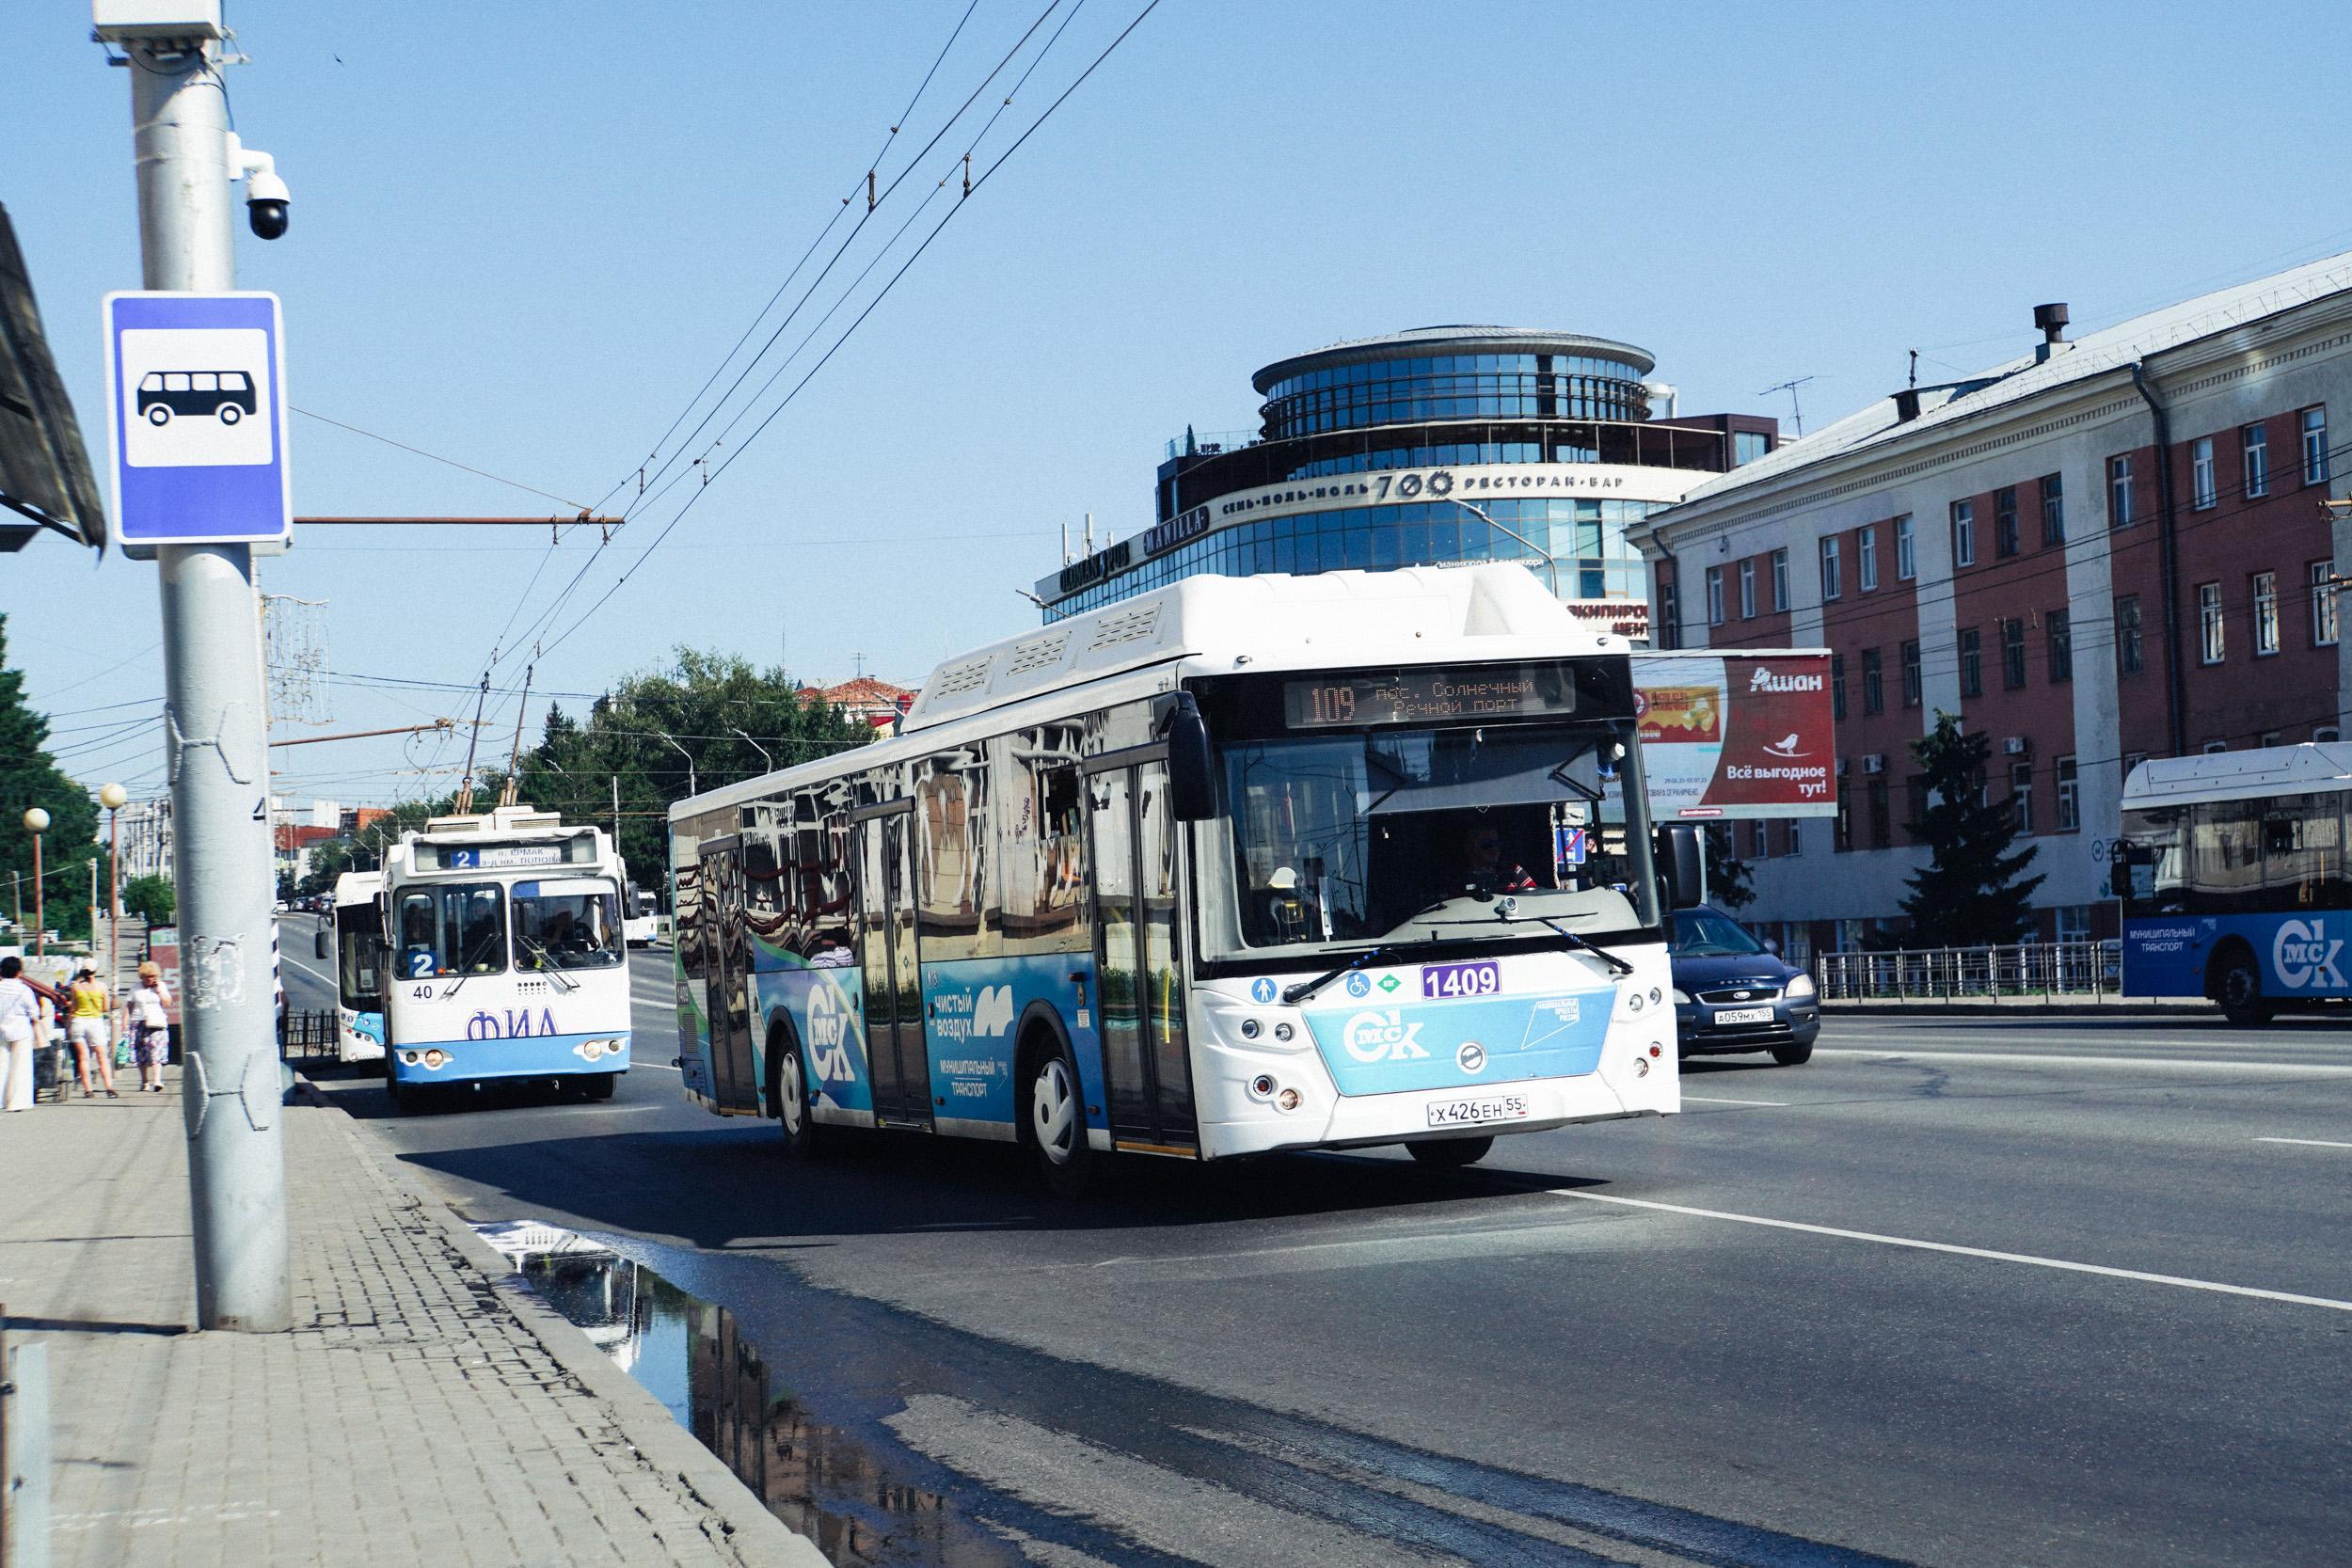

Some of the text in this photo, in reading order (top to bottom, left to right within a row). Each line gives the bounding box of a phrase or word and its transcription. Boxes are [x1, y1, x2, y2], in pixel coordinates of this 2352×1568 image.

[1379, 470, 1455, 499] 700
[1145, 508, 1203, 553] MANILLA
[1750, 667, 1822, 692] Ашан
[1375, 679, 1534, 701] пос. Солнечный
[1311, 687, 1356, 722] 109
[1393, 699, 1518, 716] Речной порт
[1727, 765, 1826, 782] Всё выгодное
[1799, 780, 1827, 798] тут!
[456, 850, 470, 867] 2
[511, 847, 543, 856] ЕРМАК
[2129, 926, 2196, 939] МУНИЦИПАЛЬНЫЙ
[2141, 942, 2184, 953] ТРАНСПОРТ
[414, 954, 434, 978] 2
[1426, 967, 1498, 998] 1409
[413, 986, 433, 999] 40
[934, 987, 973, 1013] ЧИСТЫЙ
[1719, 1011, 1756, 1022] А059МХ
[937, 1019, 974, 1044] ВОЗДУХ
[940, 1056, 995, 1075] МУНИЦИПАЛЬНЫЙ
[951, 1082, 987, 1098] ТРАНСПОРТ
[1437, 1097, 1523, 1122] Х426ЕН 55
